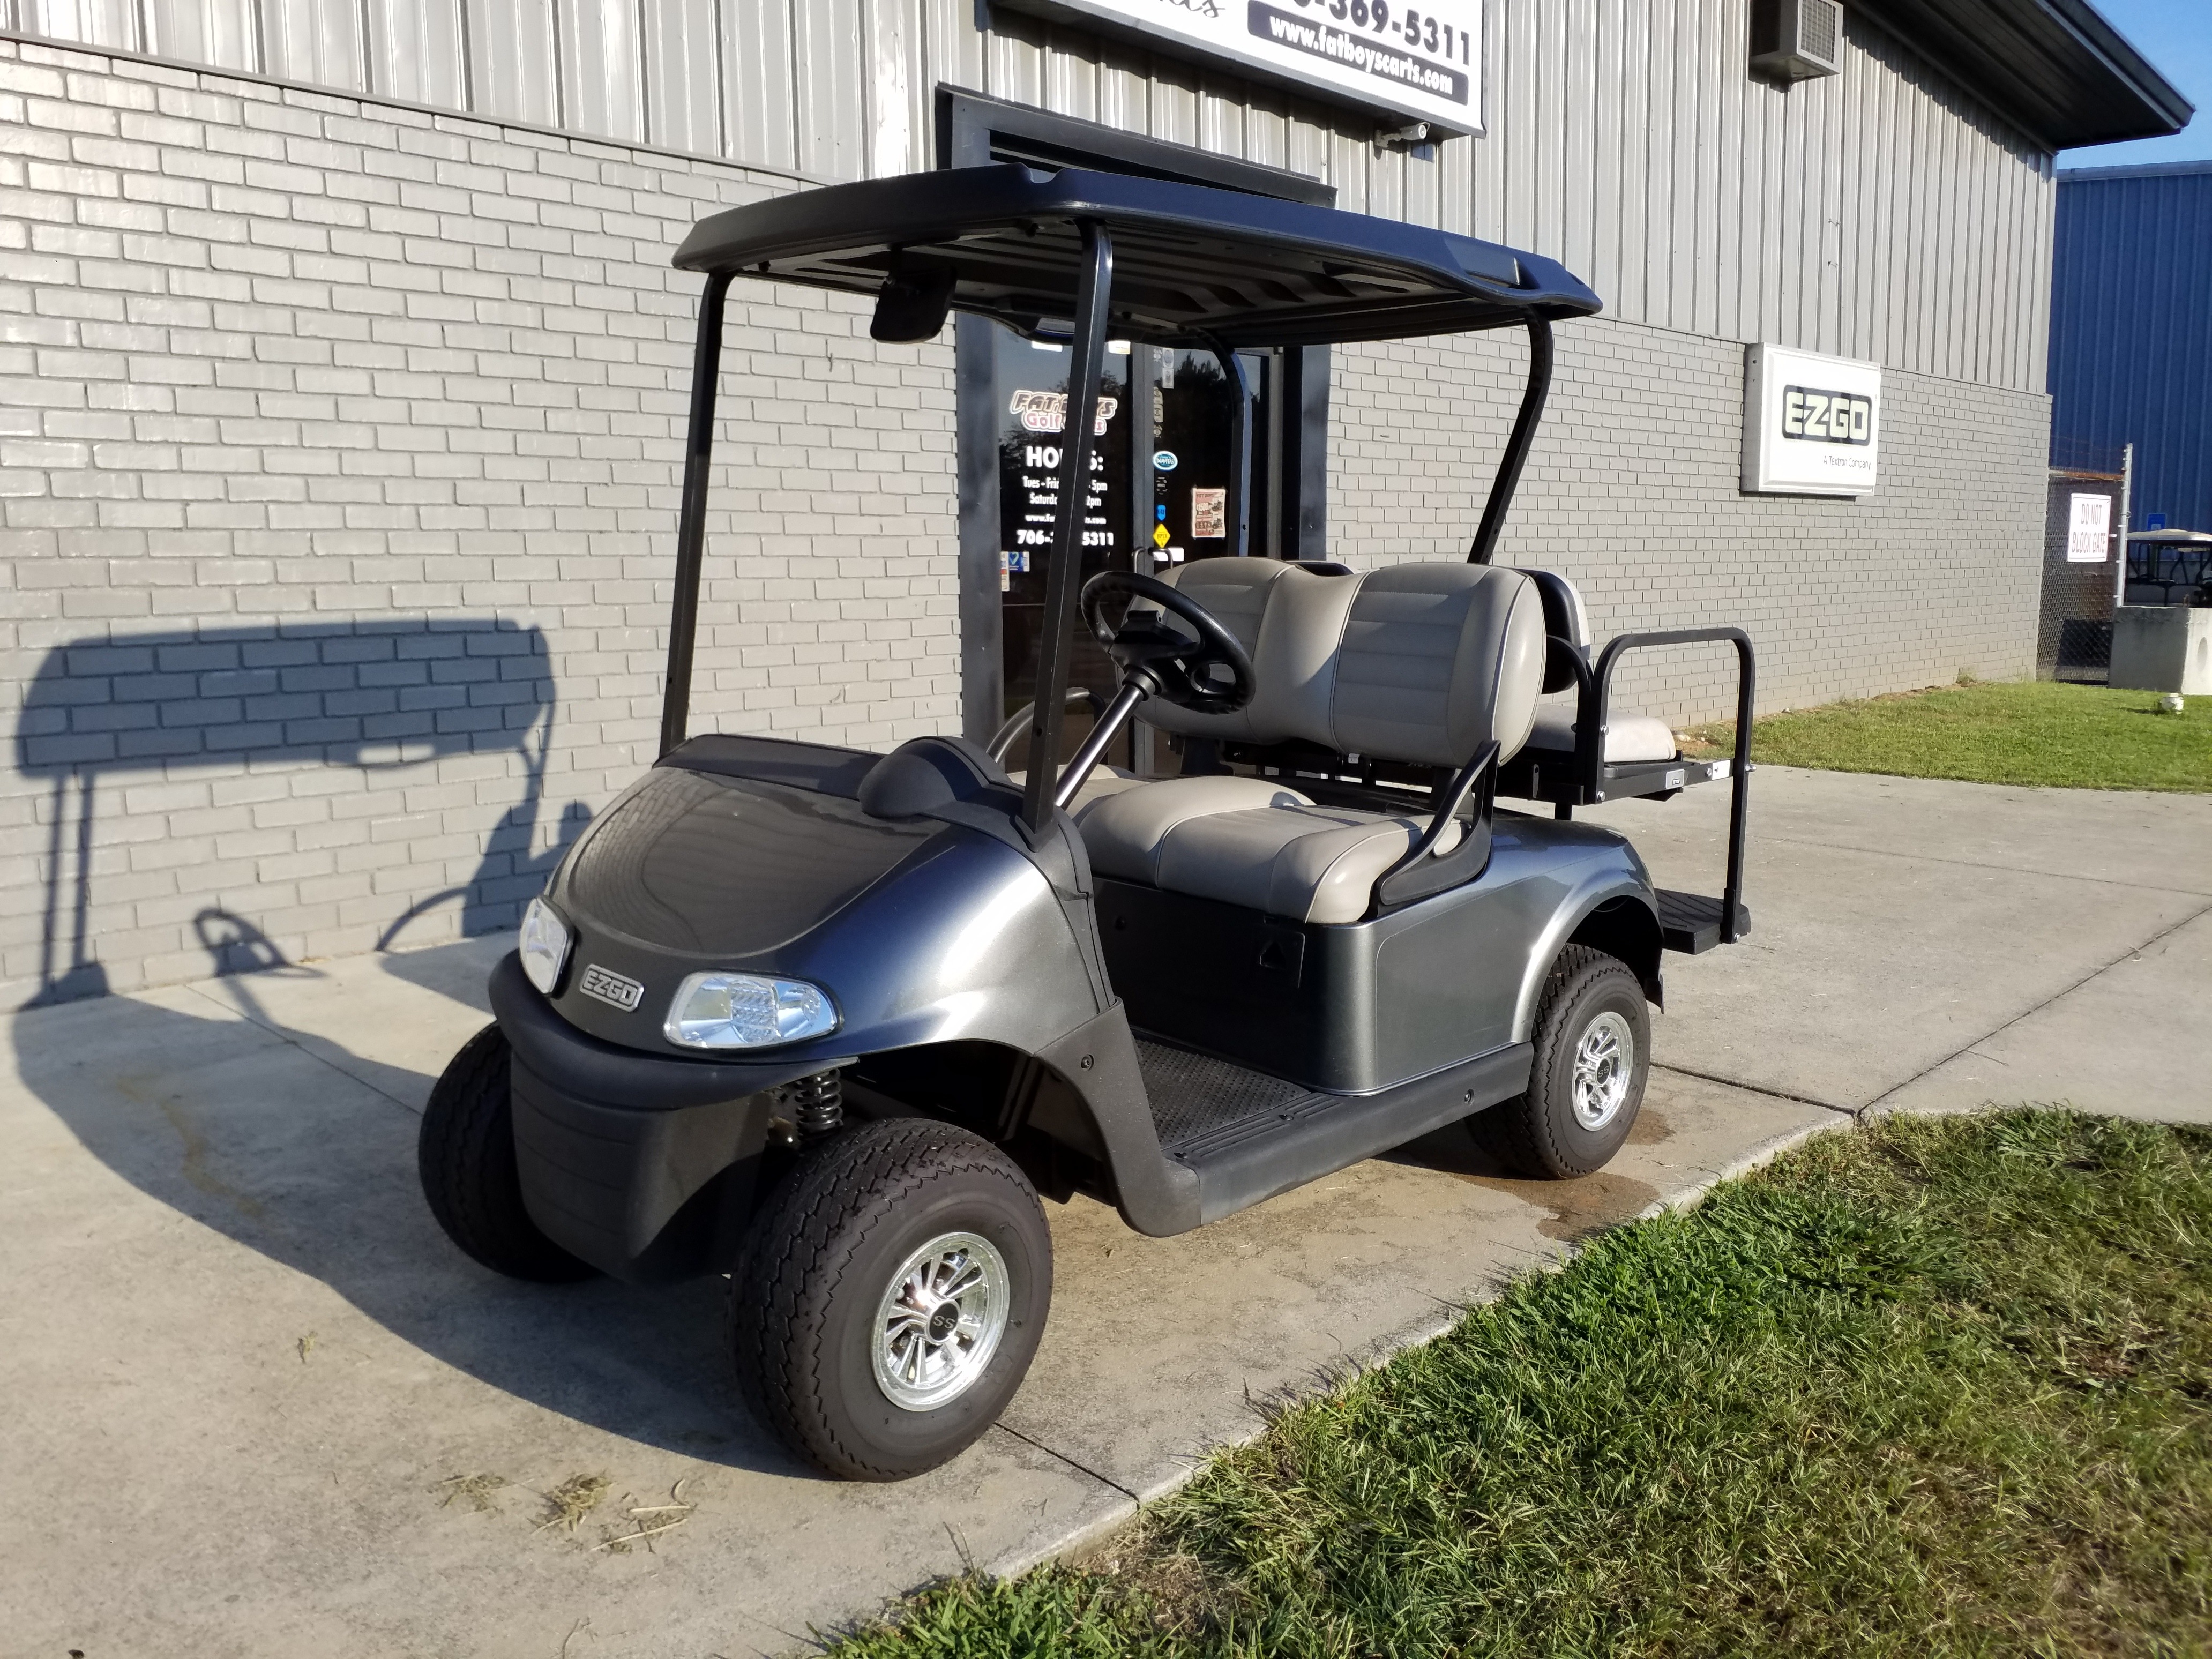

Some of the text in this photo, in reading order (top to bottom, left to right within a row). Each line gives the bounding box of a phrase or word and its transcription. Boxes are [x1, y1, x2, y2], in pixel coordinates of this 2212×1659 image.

[1294, 0, 1469, 66] -369-5311
[1269, 25, 1453, 95] www.fatboyscarts.com
[1026, 413, 1062, 427] Golf
[1785, 391, 1869, 440] EZGO
[1824, 455, 1871, 472] A Textron Company
[1022, 476, 1040, 488] Tues
[1091, 479, 1108, 494] 5pm
[2081, 503, 2102, 525] DO NOT
[2072, 532, 2106, 553] BLOCK GATE
[583, 970, 638, 1005] EZGO
[1598, 1066, 1609, 1078] SS
[933, 1315, 955, 1329] SS
